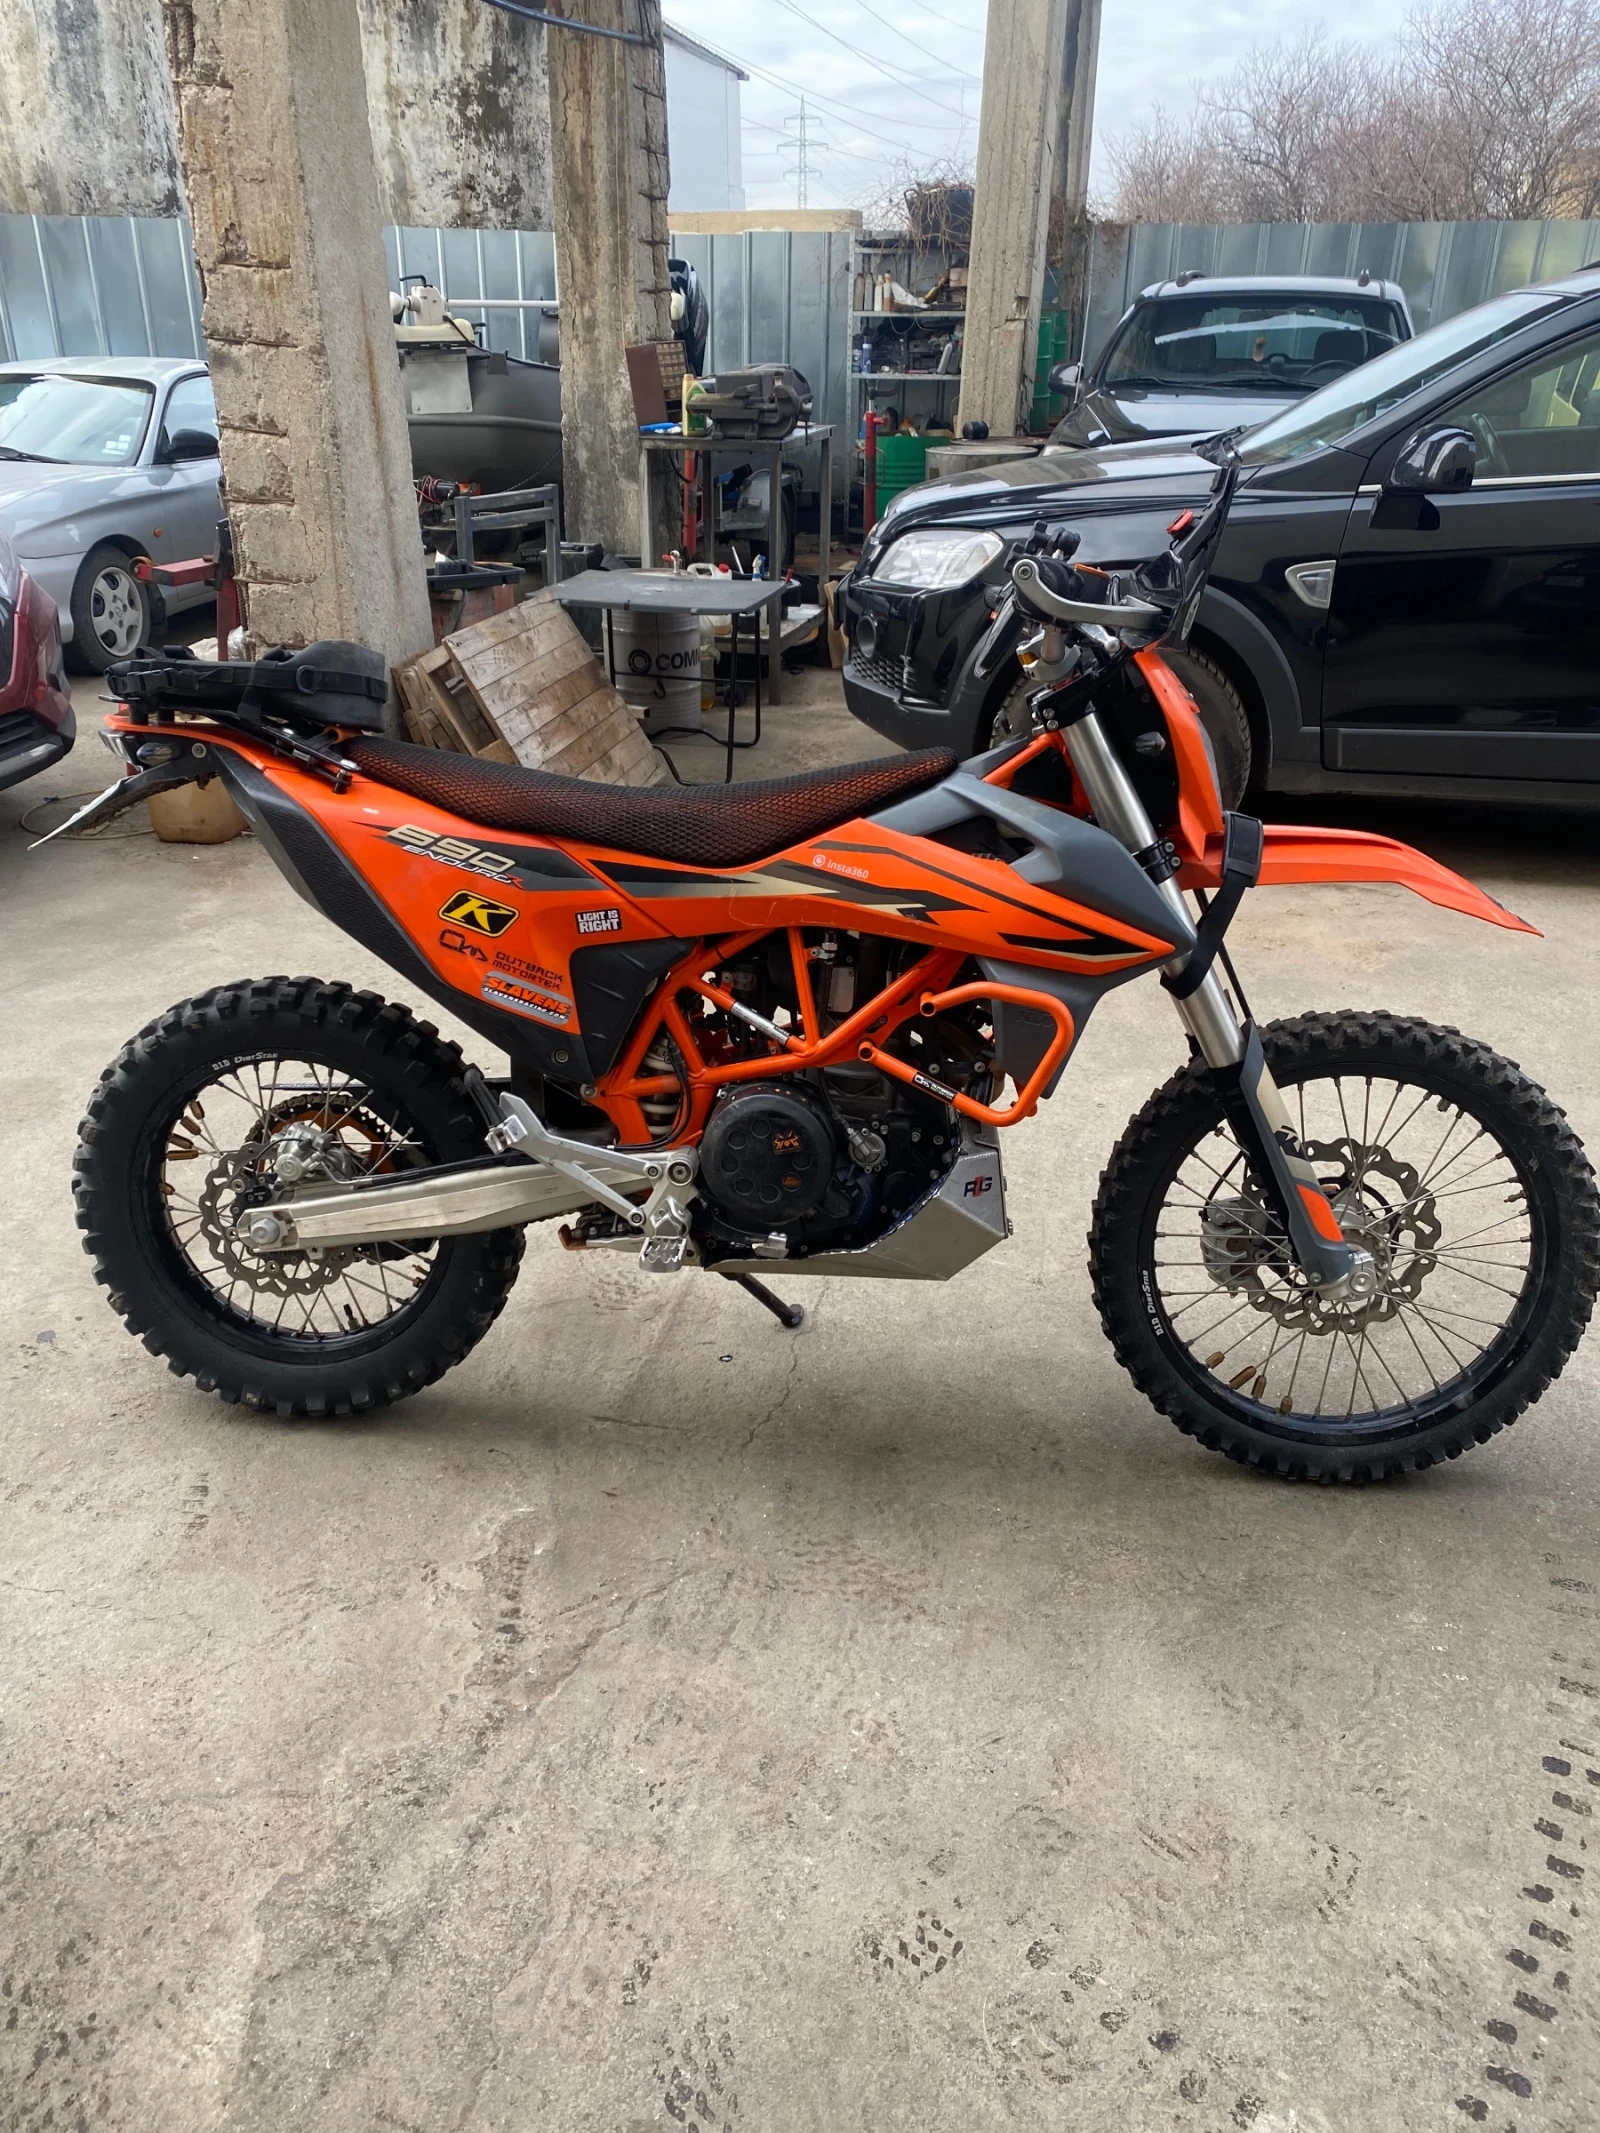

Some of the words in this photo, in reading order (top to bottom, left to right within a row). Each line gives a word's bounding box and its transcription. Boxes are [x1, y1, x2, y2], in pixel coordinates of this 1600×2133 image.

[387, 823, 516, 874] 690
[443, 896, 514, 932] K
[577, 911, 606, 922] LIGHT
[607, 909, 619, 919] IS
[579, 918, 620, 933] RIGHT
[492, 959, 561, 990] MOTORTEK
[495, 951, 564, 982] OUTBACK
[486, 976, 571, 1014] SLAVENS
